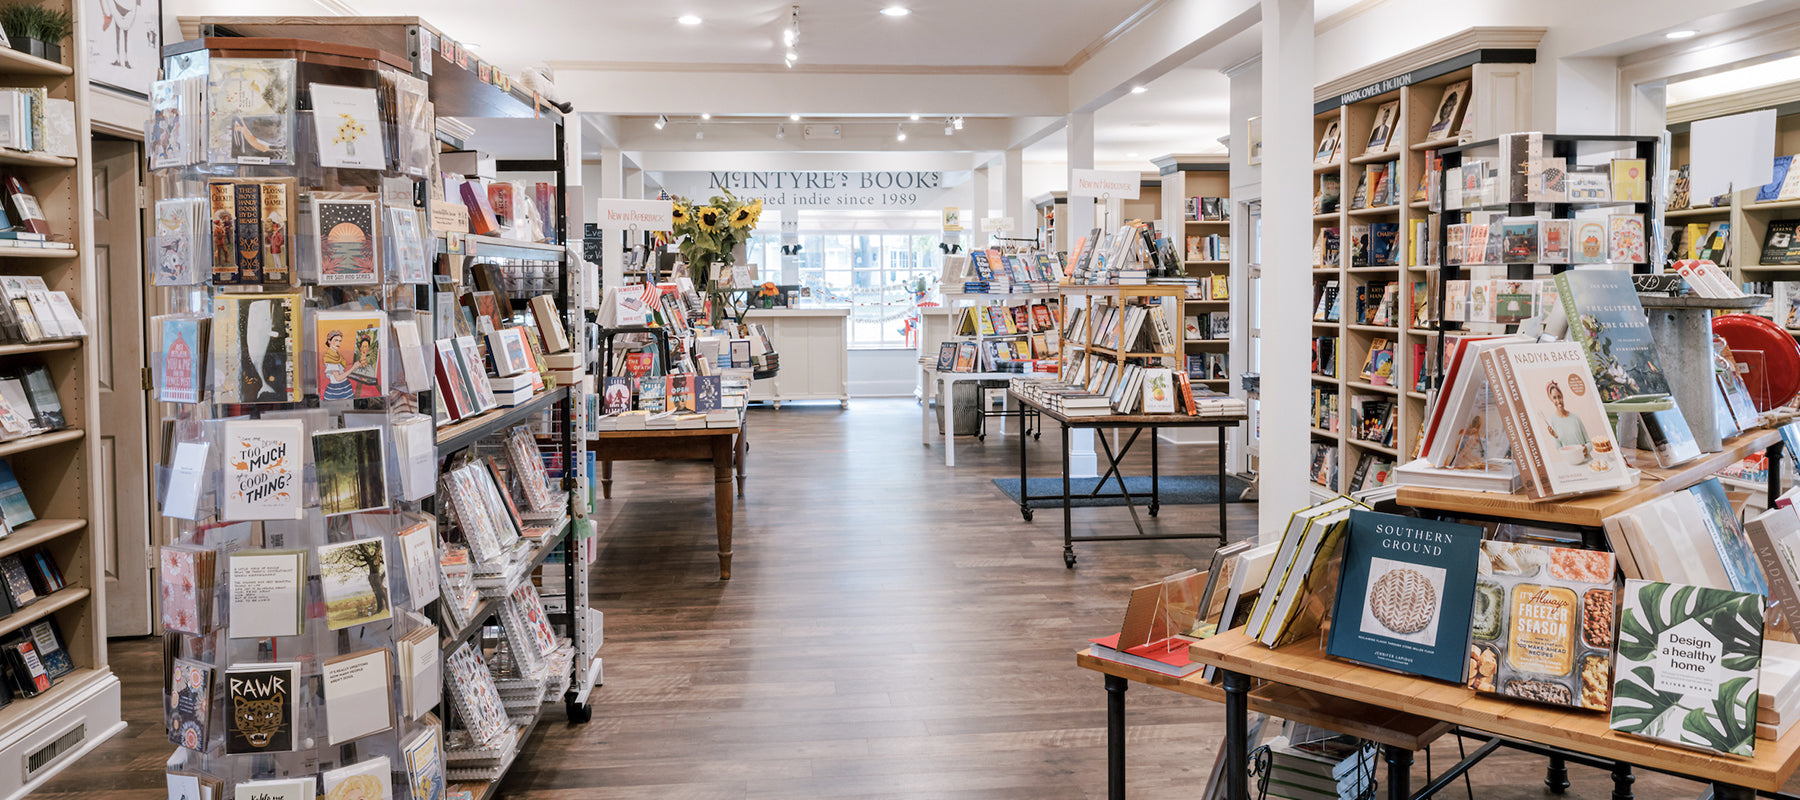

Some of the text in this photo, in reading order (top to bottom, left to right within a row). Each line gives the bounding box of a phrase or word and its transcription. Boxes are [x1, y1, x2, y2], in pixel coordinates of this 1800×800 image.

[1341, 73, 1411, 104] HARDCOVER FICTION
[793, 193, 831, 205] indie
[837, 194, 875, 205] since
[882, 193, 917, 205] 1989
[1602, 321, 1618, 329] THE
[1619, 321, 1645, 329] GREEN
[1514, 350, 1581, 365] NADIYA BAKES
[669, 395, 692, 403] WATER
[671, 386, 690, 394] OPEN
[1485, 358, 1529, 471] NADIYA BAKES NADIYA HUSSAIN
[1499, 353, 1543, 468] NADIYA BAKES NADIYA HUSSAIN
[240, 447, 261, 460] TOO
[249, 443, 286, 472] MUCH
[240, 473, 268, 491] GOOD
[246, 473, 292, 503] THING?
[1375, 524, 1453, 544] SOUTHERN
[1382, 538, 1442, 556] GROUND
[1760, 546, 1785, 587] MADE
[1782, 597, 1800, 634] LIVI
[1520, 590, 1569, 614] IT'S Always
[1519, 603, 1568, 622] FREEZER
[1517, 619, 1567, 638] SEASON
[1527, 644, 1567, 654] MAKE-AHEAD
[1669, 633, 1711, 649] Design
[1528, 650, 1554, 658] RECIPES
[1662, 647, 1717, 664] a healthy
[1670, 658, 1706, 673] home
[230, 675, 286, 700] RAWR
